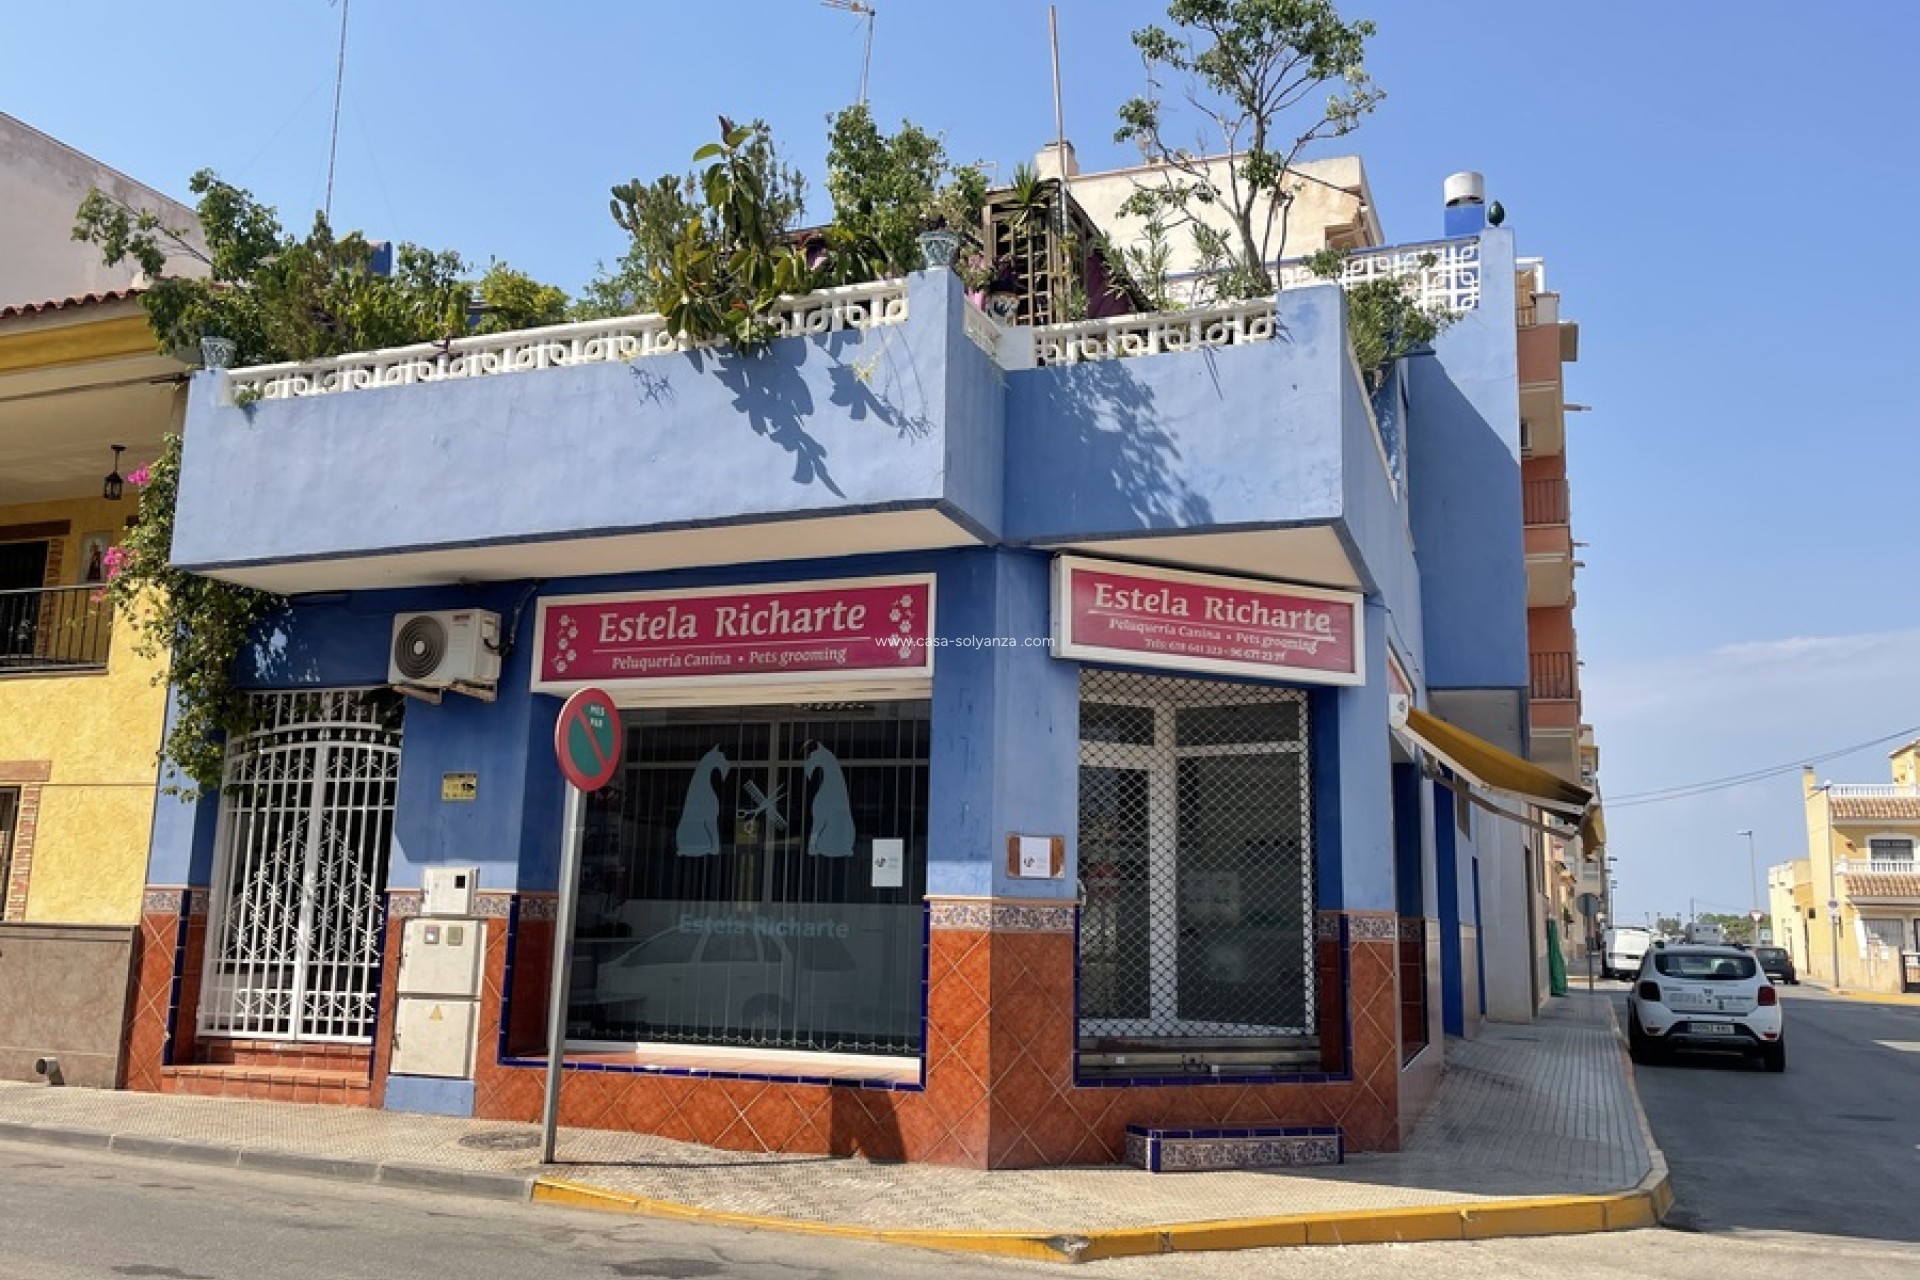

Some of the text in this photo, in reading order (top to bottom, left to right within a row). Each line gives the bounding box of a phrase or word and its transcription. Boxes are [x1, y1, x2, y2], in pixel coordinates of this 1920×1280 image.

[599, 600, 867, 642] Estela Richarte
[1094, 583, 1330, 633] Estela Richarte
[1179, 625, 1222, 640] Canina
[1261, 636, 1318, 655] grooming
[684, 652, 731, 667] Canina
[748, 649, 777, 664] Pets
[779, 646, 847, 666] grooming
[679, 914, 851, 938] Estela Richarte
